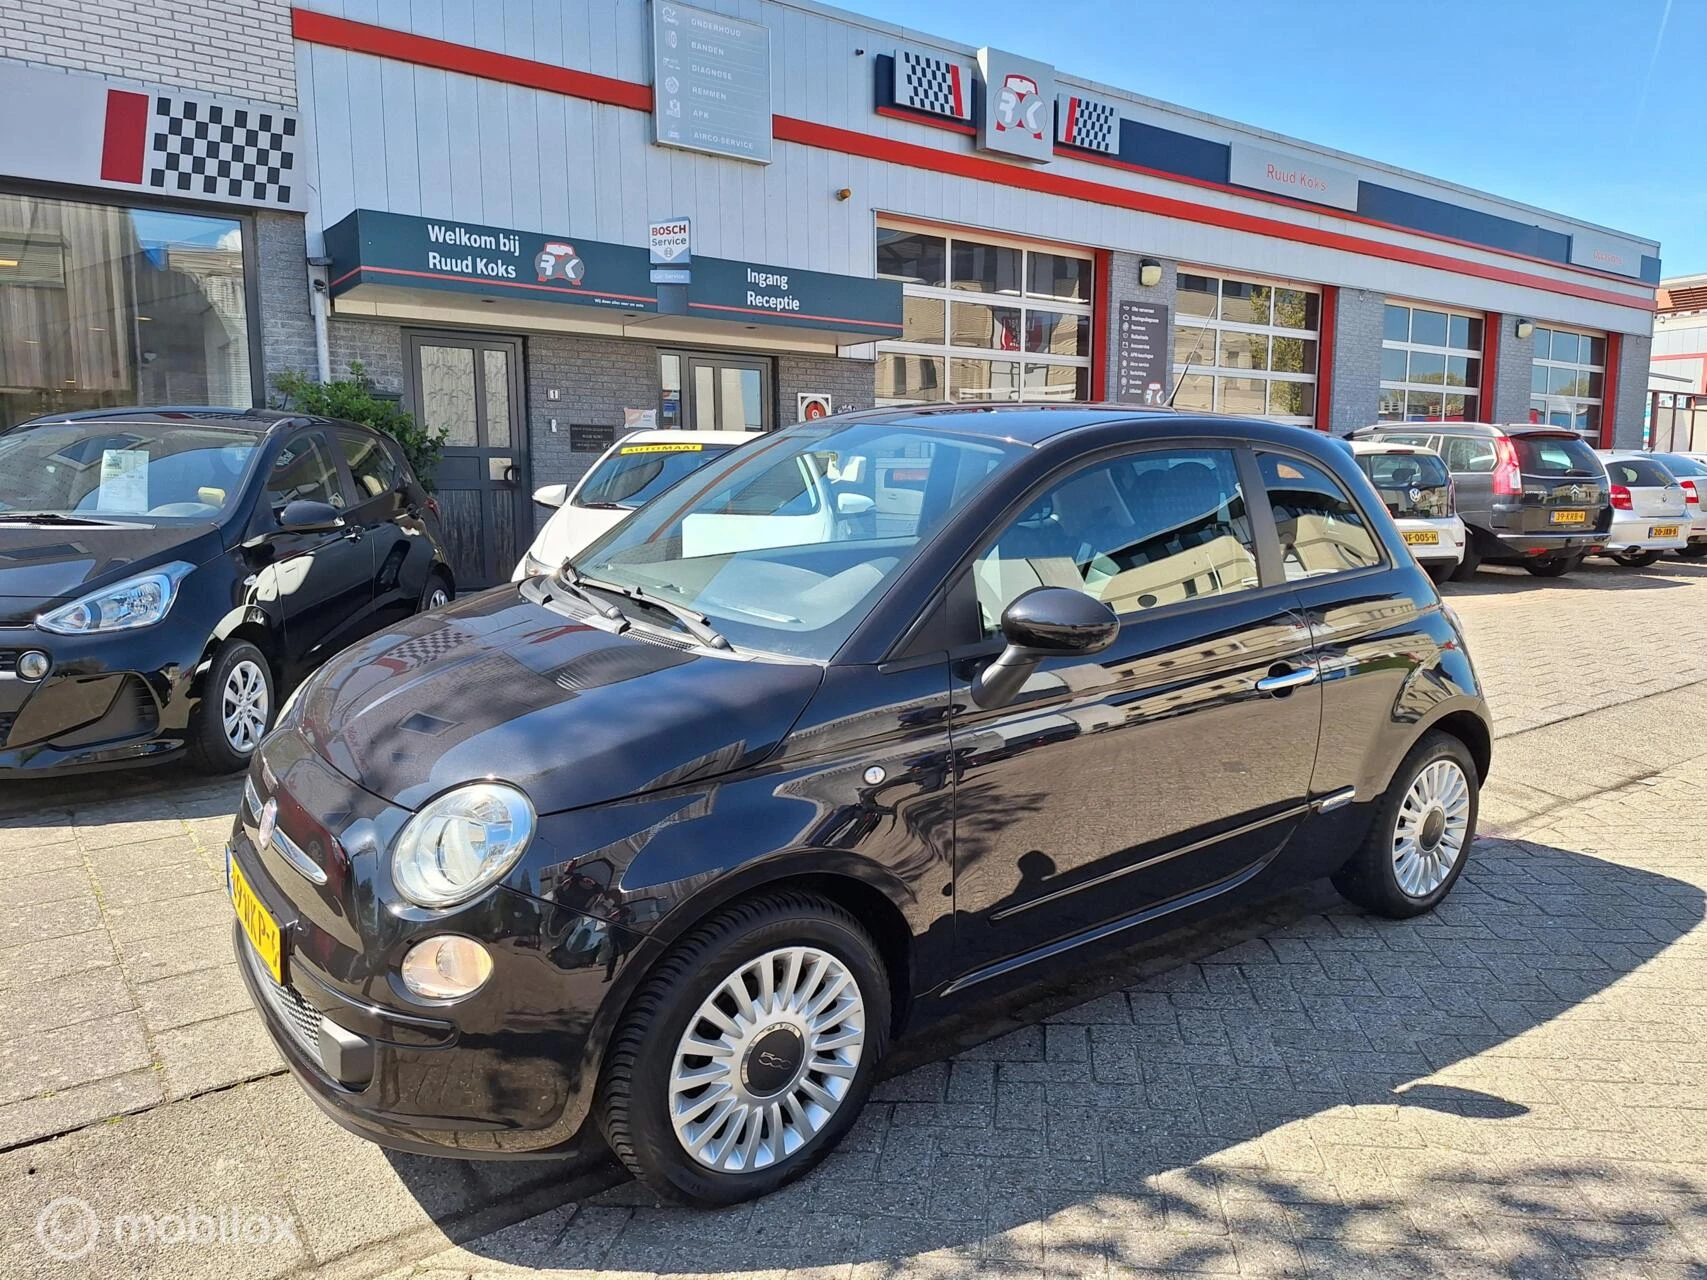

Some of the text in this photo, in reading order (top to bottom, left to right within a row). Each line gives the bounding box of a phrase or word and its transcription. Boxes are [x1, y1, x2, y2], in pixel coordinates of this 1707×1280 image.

[690, 18, 741, 37] ONDERHOUD
[691, 41, 724, 56] BANDEN
[692, 64, 732, 80] DIAGNOSE
[692, 86, 727, 100] REMMEN
[693, 109, 709, 119] APK
[1267, 163, 1327, 191] Ruud Koks
[651, 225, 687, 236] BOSCH
[427, 224, 520, 256] Welkom bij
[651, 236, 687, 247] Service
[428, 251, 516, 278] Ruud Koks
[747, 267, 788, 290] Ingang
[747, 290, 800, 311] Receptie
[626, 445, 697, 453] AUTOMAAT
